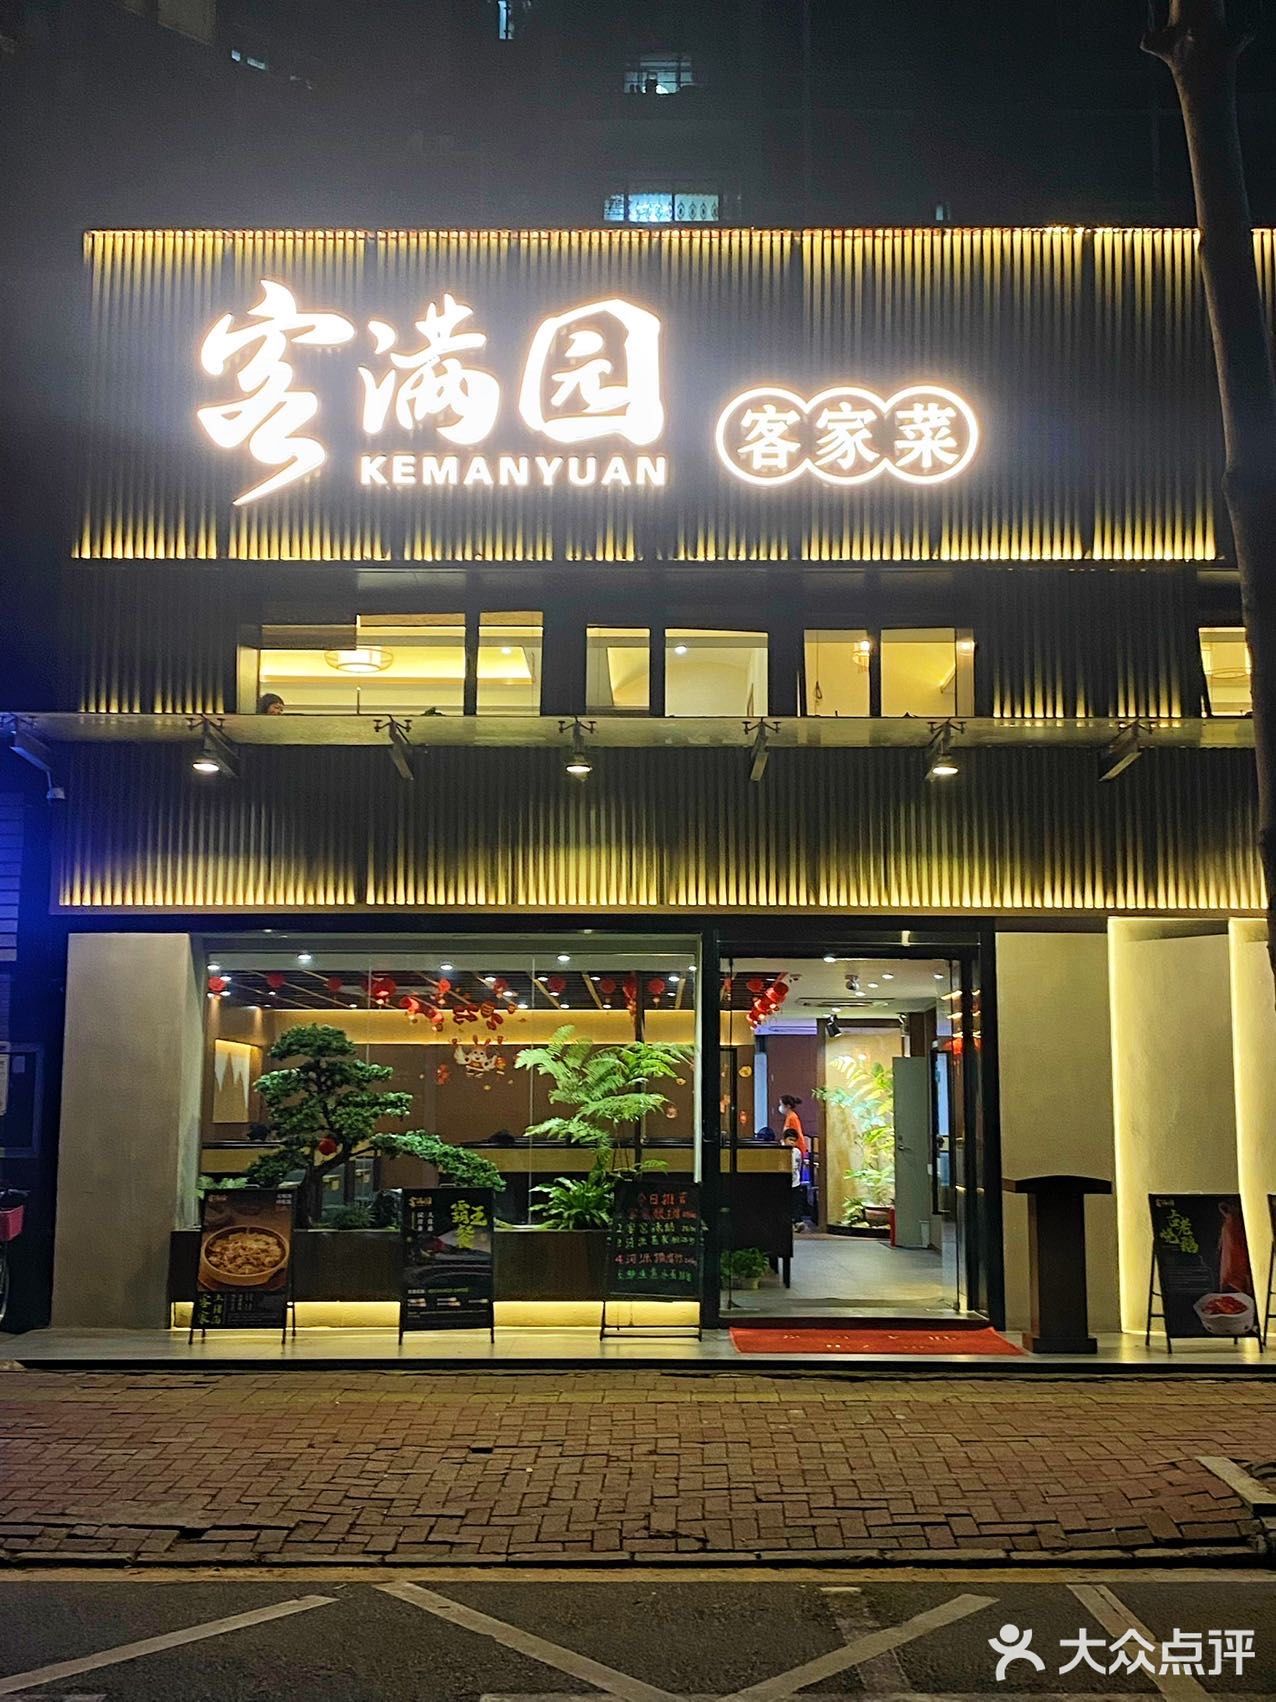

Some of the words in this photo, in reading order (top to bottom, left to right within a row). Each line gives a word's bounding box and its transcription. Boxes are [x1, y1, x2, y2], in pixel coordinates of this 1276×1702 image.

[197, 279, 665, 506] 客满园
[737, 402, 960, 469] 客家菜
[360, 456, 667, 485] KEMANYUAN
